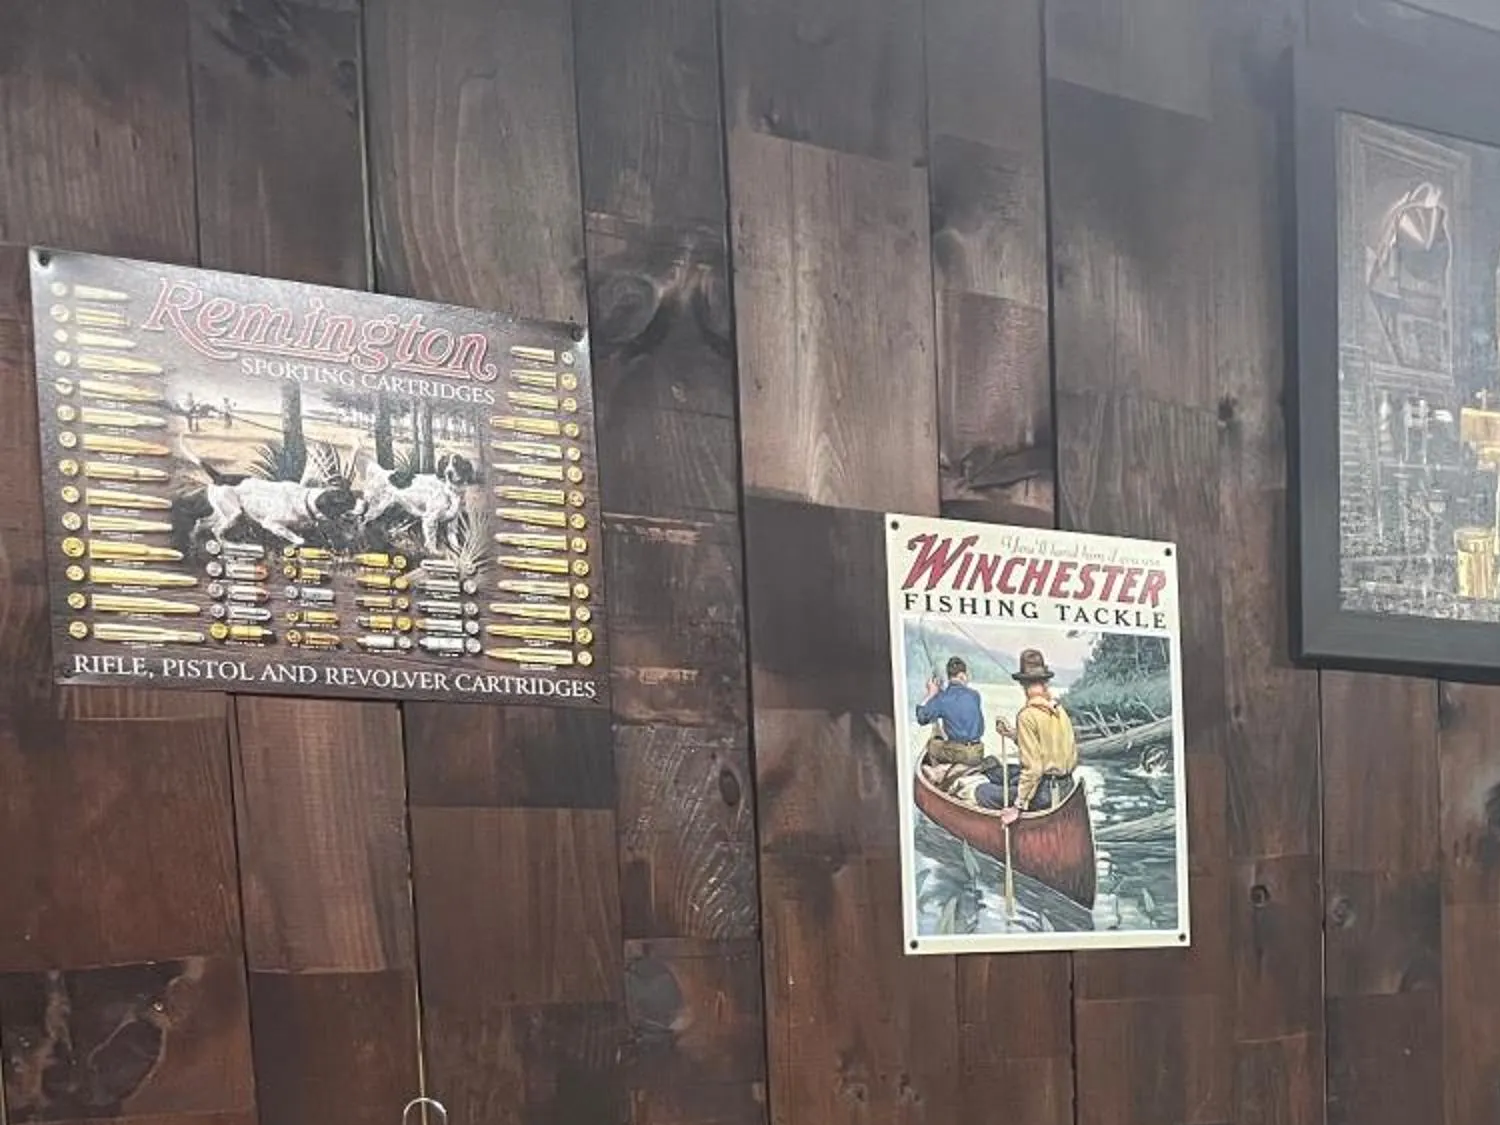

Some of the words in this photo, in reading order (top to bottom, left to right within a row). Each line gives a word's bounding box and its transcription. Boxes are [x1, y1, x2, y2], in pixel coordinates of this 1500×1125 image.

[140, 277, 498, 382] Remington
[240, 357, 355, 387] SPORTING
[361, 373, 496, 405] CARTRIDGES
[901, 533, 1168, 609] WINCHESTER
[903, 593, 1040, 619] FISHING
[1055, 604, 1168, 629] TACKLE
[73, 654, 154, 679] RIFLE,
[162, 657, 255, 682] PISTOL
[260, 663, 318, 685] AND
[325, 667, 450, 690] REVOLVER
[455, 673, 597, 699] CARTRIDGES
